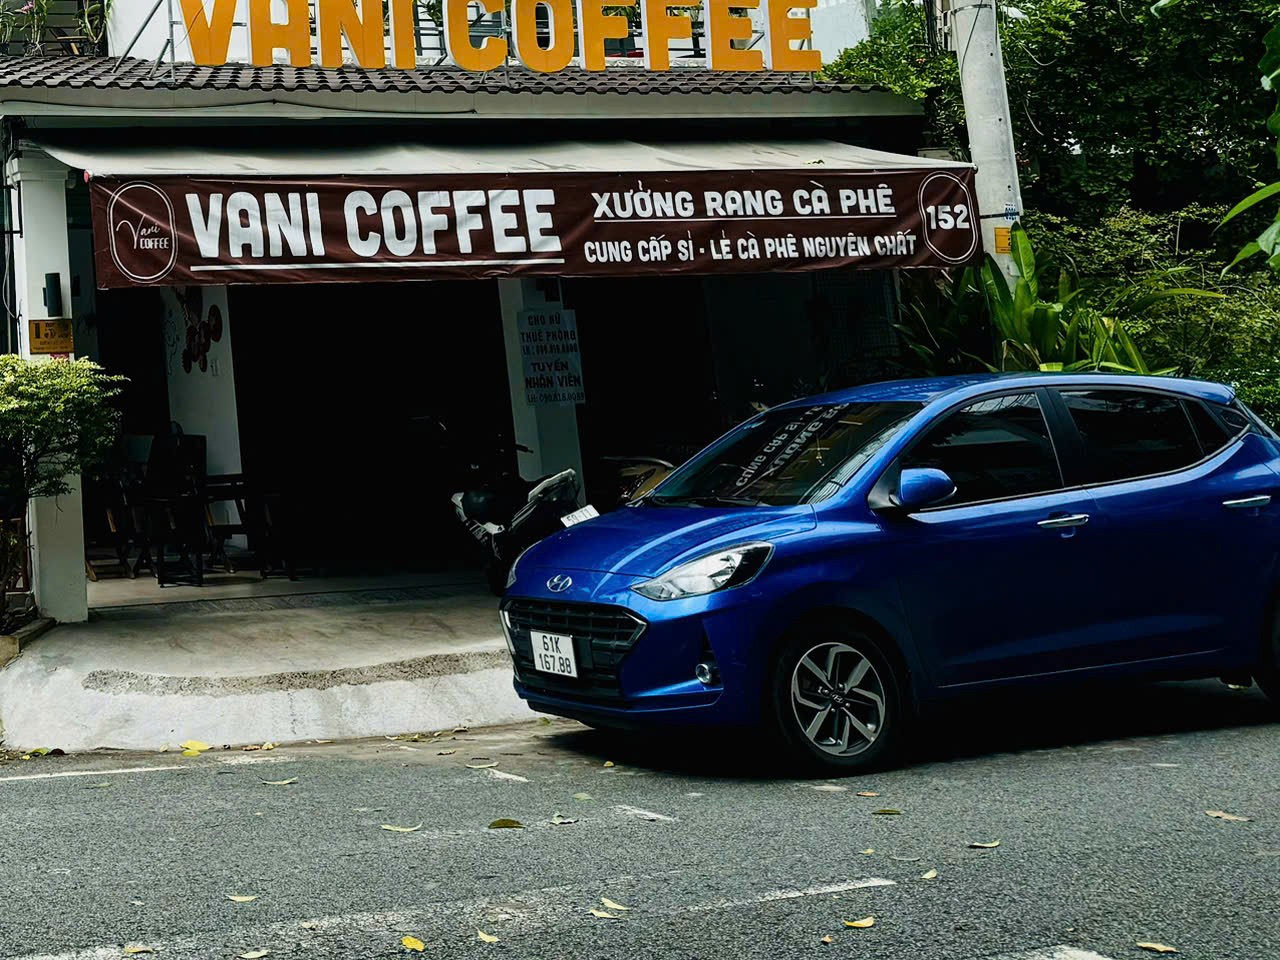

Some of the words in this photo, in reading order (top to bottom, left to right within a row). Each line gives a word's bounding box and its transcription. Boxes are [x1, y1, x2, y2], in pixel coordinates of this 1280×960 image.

[591, 180, 695, 218] XƯỞNG
[704, 190, 784, 217] RANG
[792, 180, 831, 216] CÀ
[839, 183, 896, 215] PHÊ
[185, 191, 326, 259] VANI
[344, 188, 562, 258] COFFEE
[926, 203, 971, 230] 152
[140, 237, 170, 250] COFFEE
[584, 240, 633, 263] CUNG
[637, 234, 672, 262] CẤP
[677, 230, 695, 262] SỈ
[710, 230, 733, 260] LẺ
[737, 231, 761, 260] CÀ
[764, 233, 799, 259] PHÊ
[802, 232, 871, 259] NGUYÊN
[874, 229, 917, 257] CHẤT
[542, 635, 562, 654] 61K
[539, 653, 572, 675] 167.88
